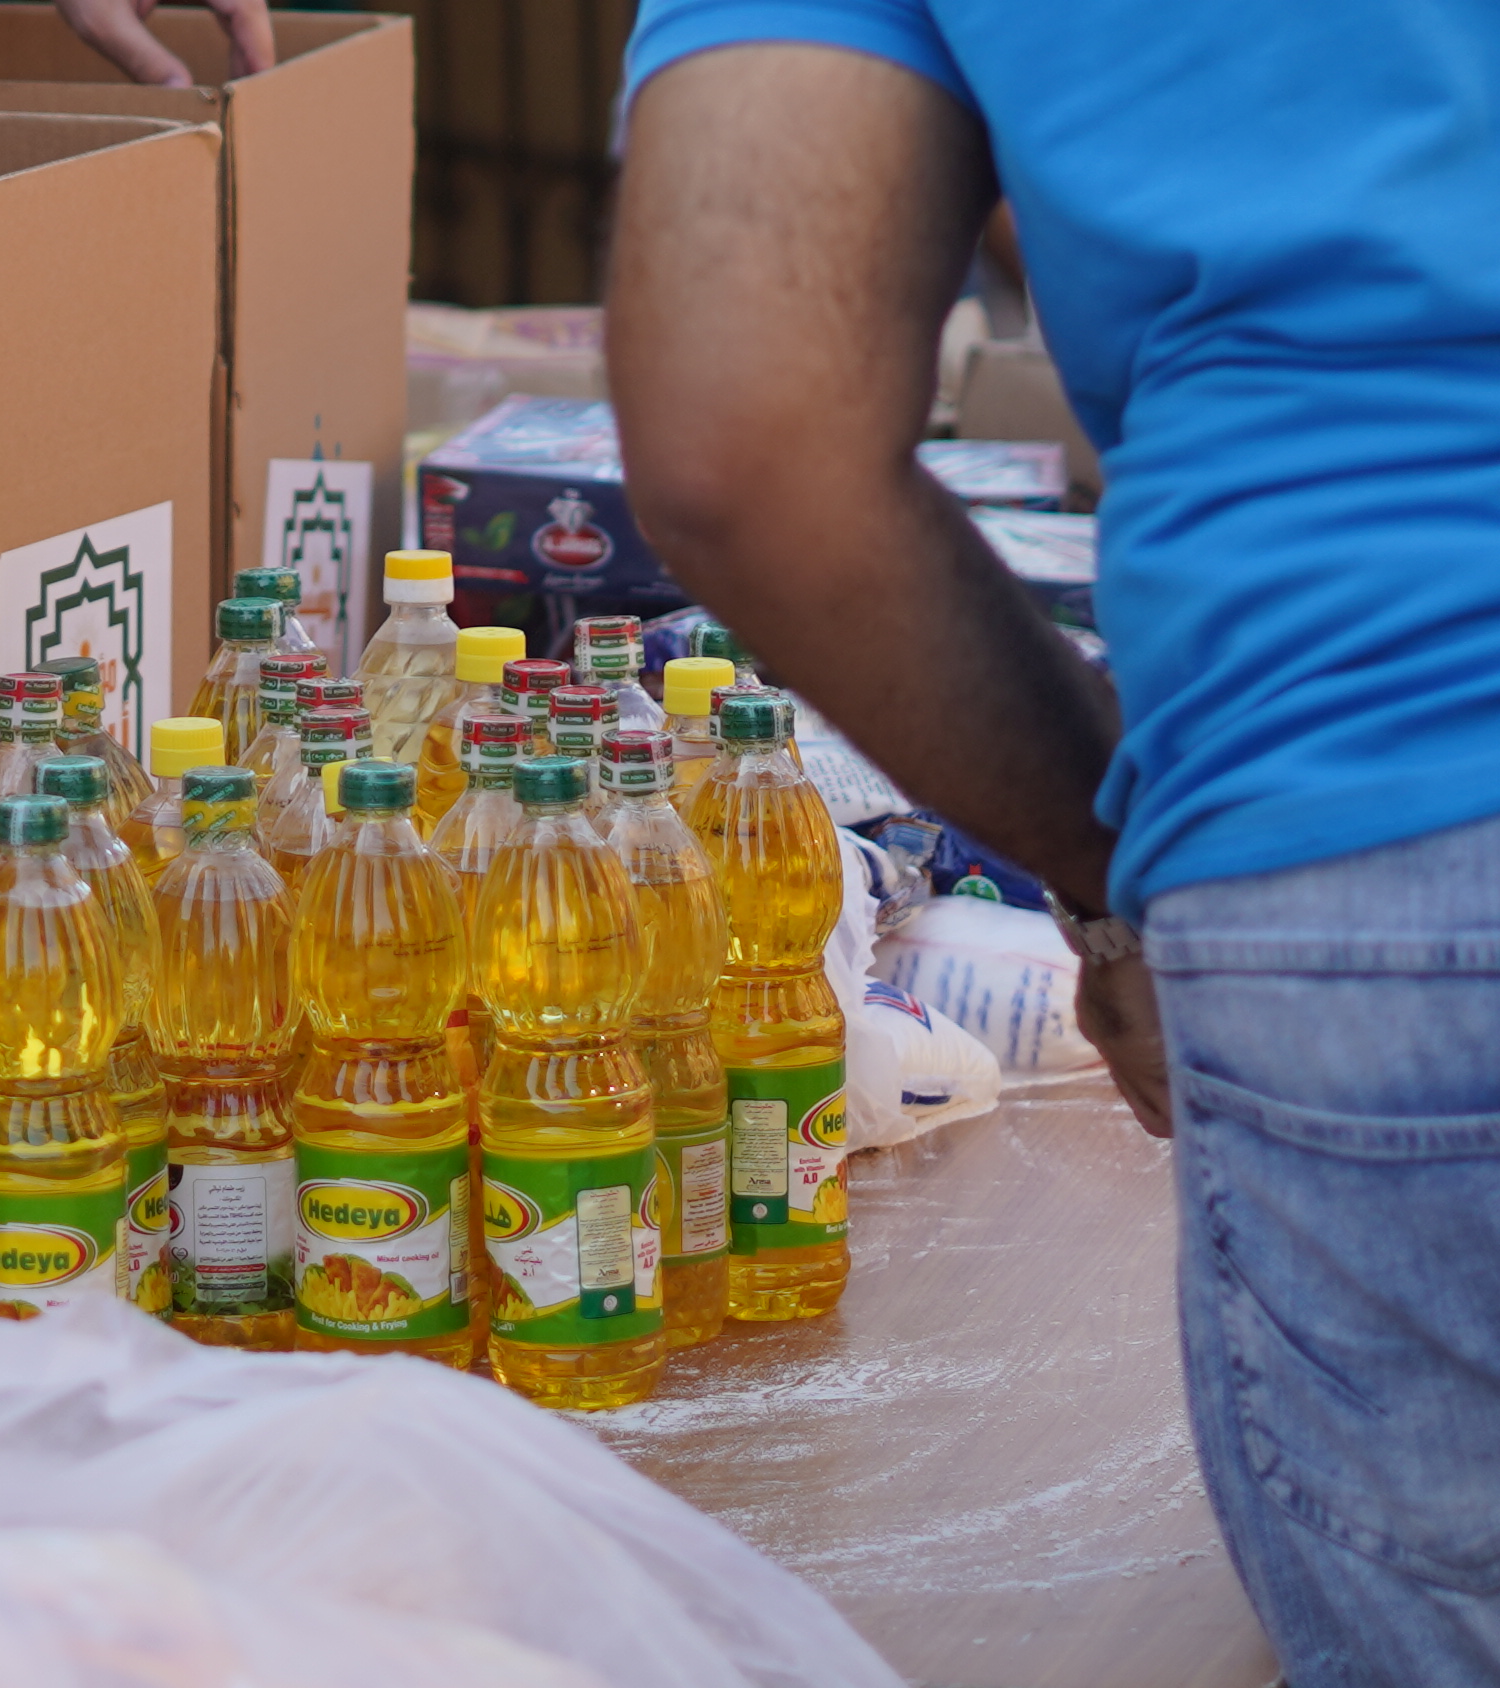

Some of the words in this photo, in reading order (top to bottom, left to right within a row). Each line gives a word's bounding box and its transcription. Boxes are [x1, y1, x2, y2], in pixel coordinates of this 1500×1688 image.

[307, 1197, 400, 1230] Hedeya
[376, 1254, 400, 1263] Mixed
[401, 1253, 430, 1262] cooking
[336, 1320, 371, 1333] Cooking
[371, 1322, 379, 1331] &
[380, 1319, 408, 1331] Frying
